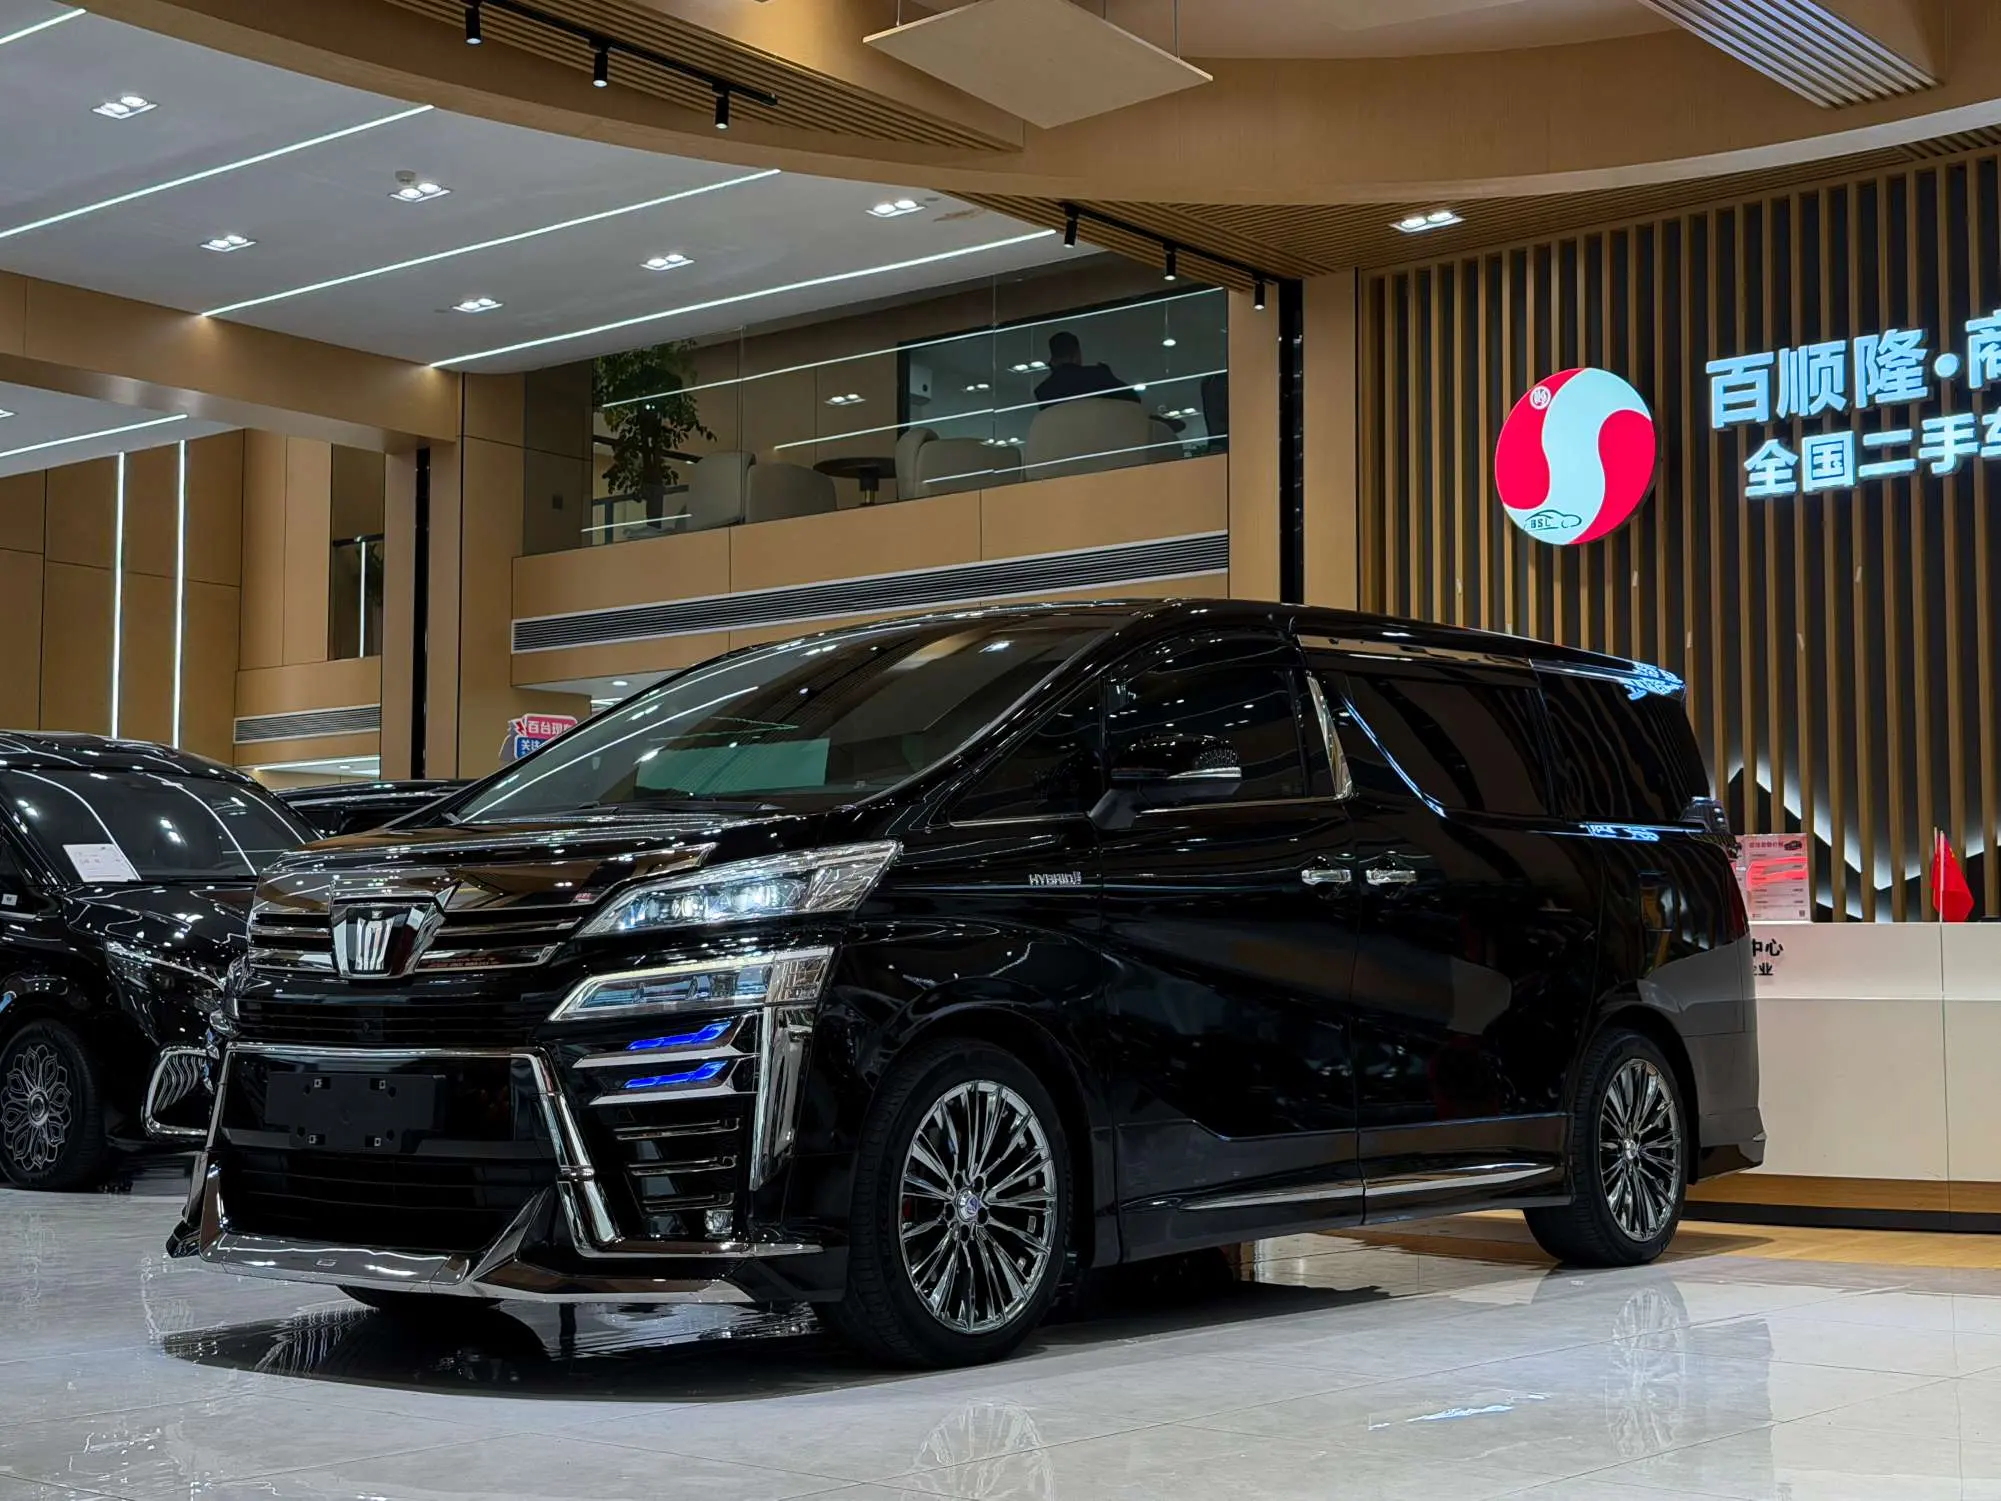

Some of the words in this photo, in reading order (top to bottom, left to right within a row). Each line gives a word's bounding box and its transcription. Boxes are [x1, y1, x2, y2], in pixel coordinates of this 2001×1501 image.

[1530, 518, 1551, 528] BSL
[1029, 873, 1073, 886] HYBRID
[1753, 962, 1774, 976] 业
